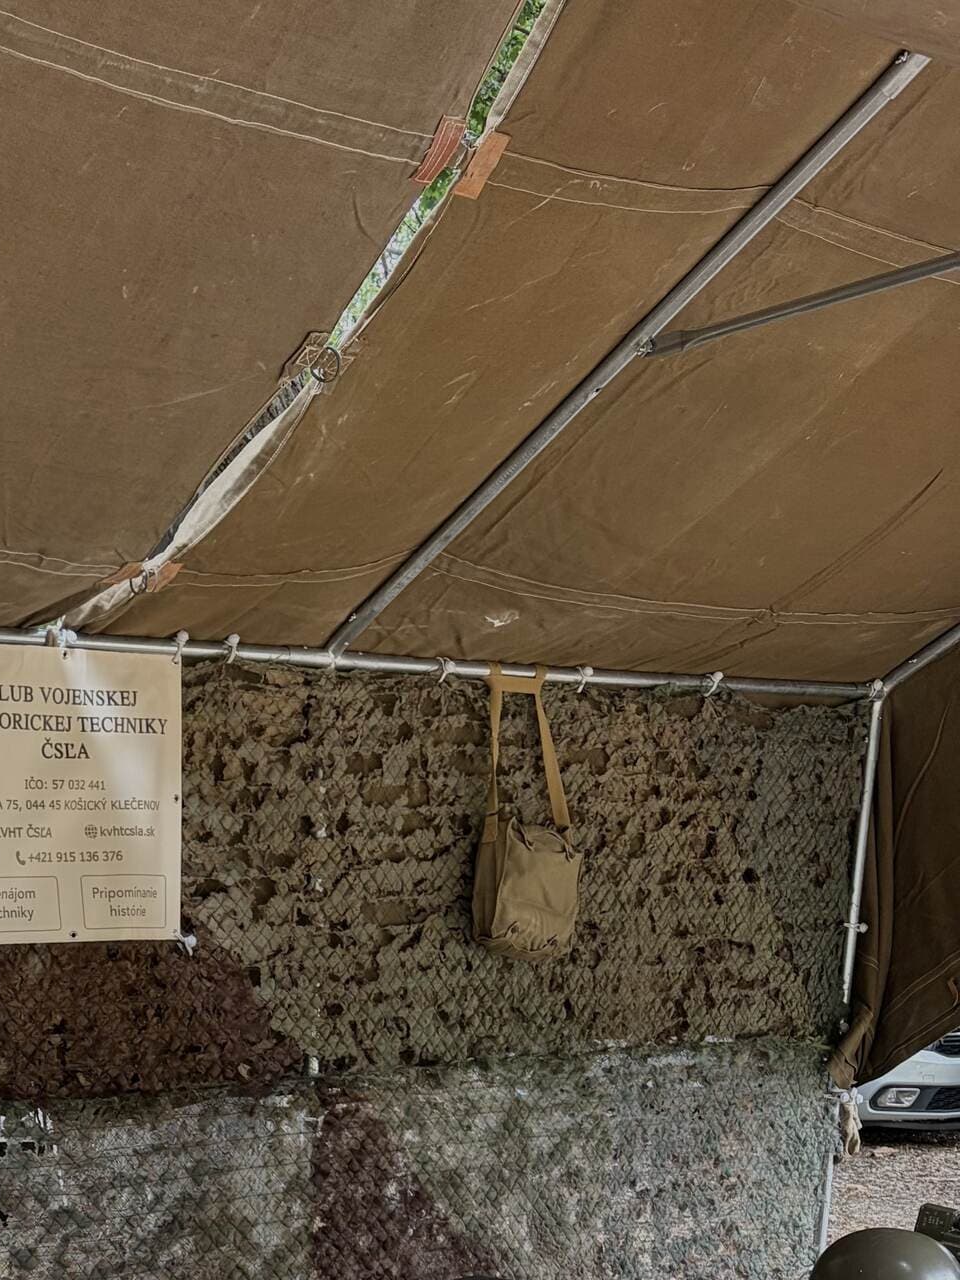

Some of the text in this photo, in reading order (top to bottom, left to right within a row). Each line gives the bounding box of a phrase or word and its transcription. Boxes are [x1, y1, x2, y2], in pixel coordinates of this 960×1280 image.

[39, 686, 138, 707] VOJENSKEJ
[77, 716, 168, 735] TECHNIKY
[41, 737, 90, 760] ČSĽA
[24, 776, 106, 791] IČO: 57 032 441
[6, 799, 22, 812] 75,
[25, 799, 45, 811] 044
[49, 799, 62, 811] 45
[64, 798, 106, 811] KOŠICKÝ
[110, 797, 160, 811] KLEČENOV
[26, 824, 53, 839] ČSĽA
[28, 850, 124, 863] +421 915 136 376
[91, 885, 158, 902] Pripomínanie
[109, 904, 147, 918] histórie
